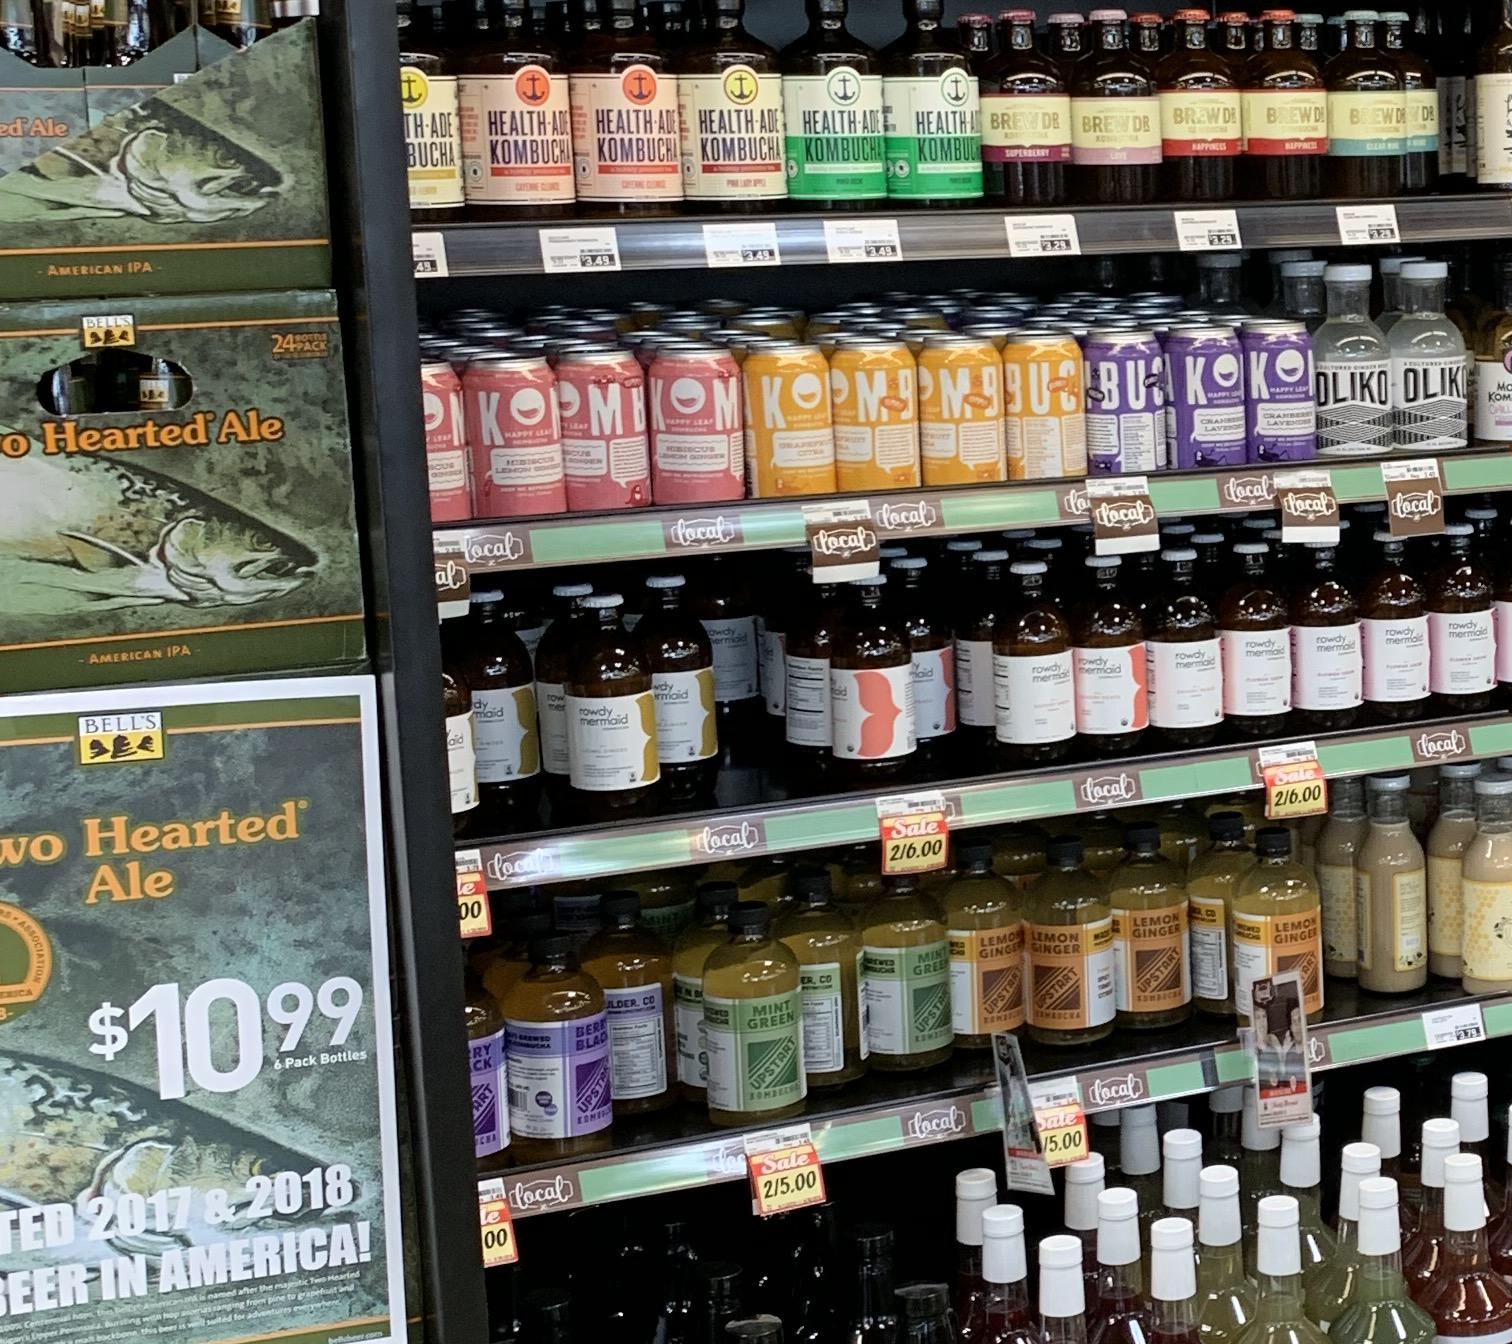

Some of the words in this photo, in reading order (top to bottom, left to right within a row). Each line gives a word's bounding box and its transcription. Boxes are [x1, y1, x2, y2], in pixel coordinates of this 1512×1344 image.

[1082, 116, 1131, 132] BREW
[1173, 108, 1218, 124] BREW
[48, 261, 122, 276] AMERICAN
[128, 261, 153, 274] IPA
[272, 333, 295, 352] 24
[296, 341, 327, 351] PACK
[1315, 370, 1388, 406] OLIKO
[43, 413, 210, 455] Hearted
[218, 409, 283, 444] Ale
[676, 516, 730, 544] local
[818, 528, 872, 549] local
[1078, 658, 1109, 668] rowdy
[579, 707, 612, 718] rowdy
[85, 715, 157, 733] BELL'S
[1274, 785, 1321, 807] 2/6.00
[83, 800, 298, 857] Hearted
[892, 817, 939, 836] Sale
[888, 840, 943, 861] 2/6.00
[85, 862, 173, 904] Ale
[1132, 914, 1180, 929] LEMON
[1132, 924, 1182, 939] GINGER
[1031, 931, 1080, 943] LEMON
[1030, 942, 1081, 955] GINGER
[1136, 947, 1181, 993] UPSTART
[1034, 969, 1079, 1010] UPSTART
[752, 1000, 792, 1017] MINT
[747, 1011, 795, 1029] GREEN
[274, 1059, 283, 1070] 6
[284, 1055, 317, 1069] Pack
[320, 1049, 367, 1065] Bottles
[751, 1037, 795, 1089] UPSTART
[761, 1152, 810, 1173] Sale
[763, 1174, 816, 1197] 2/5.00
[88, 1187, 191, 1241] 2017
[205, 1189, 236, 1225] &
[245, 1164, 353, 1219] 2018
[101, 1257, 148, 1300] IN
[159, 1221, 373, 1293] AMERICA!
